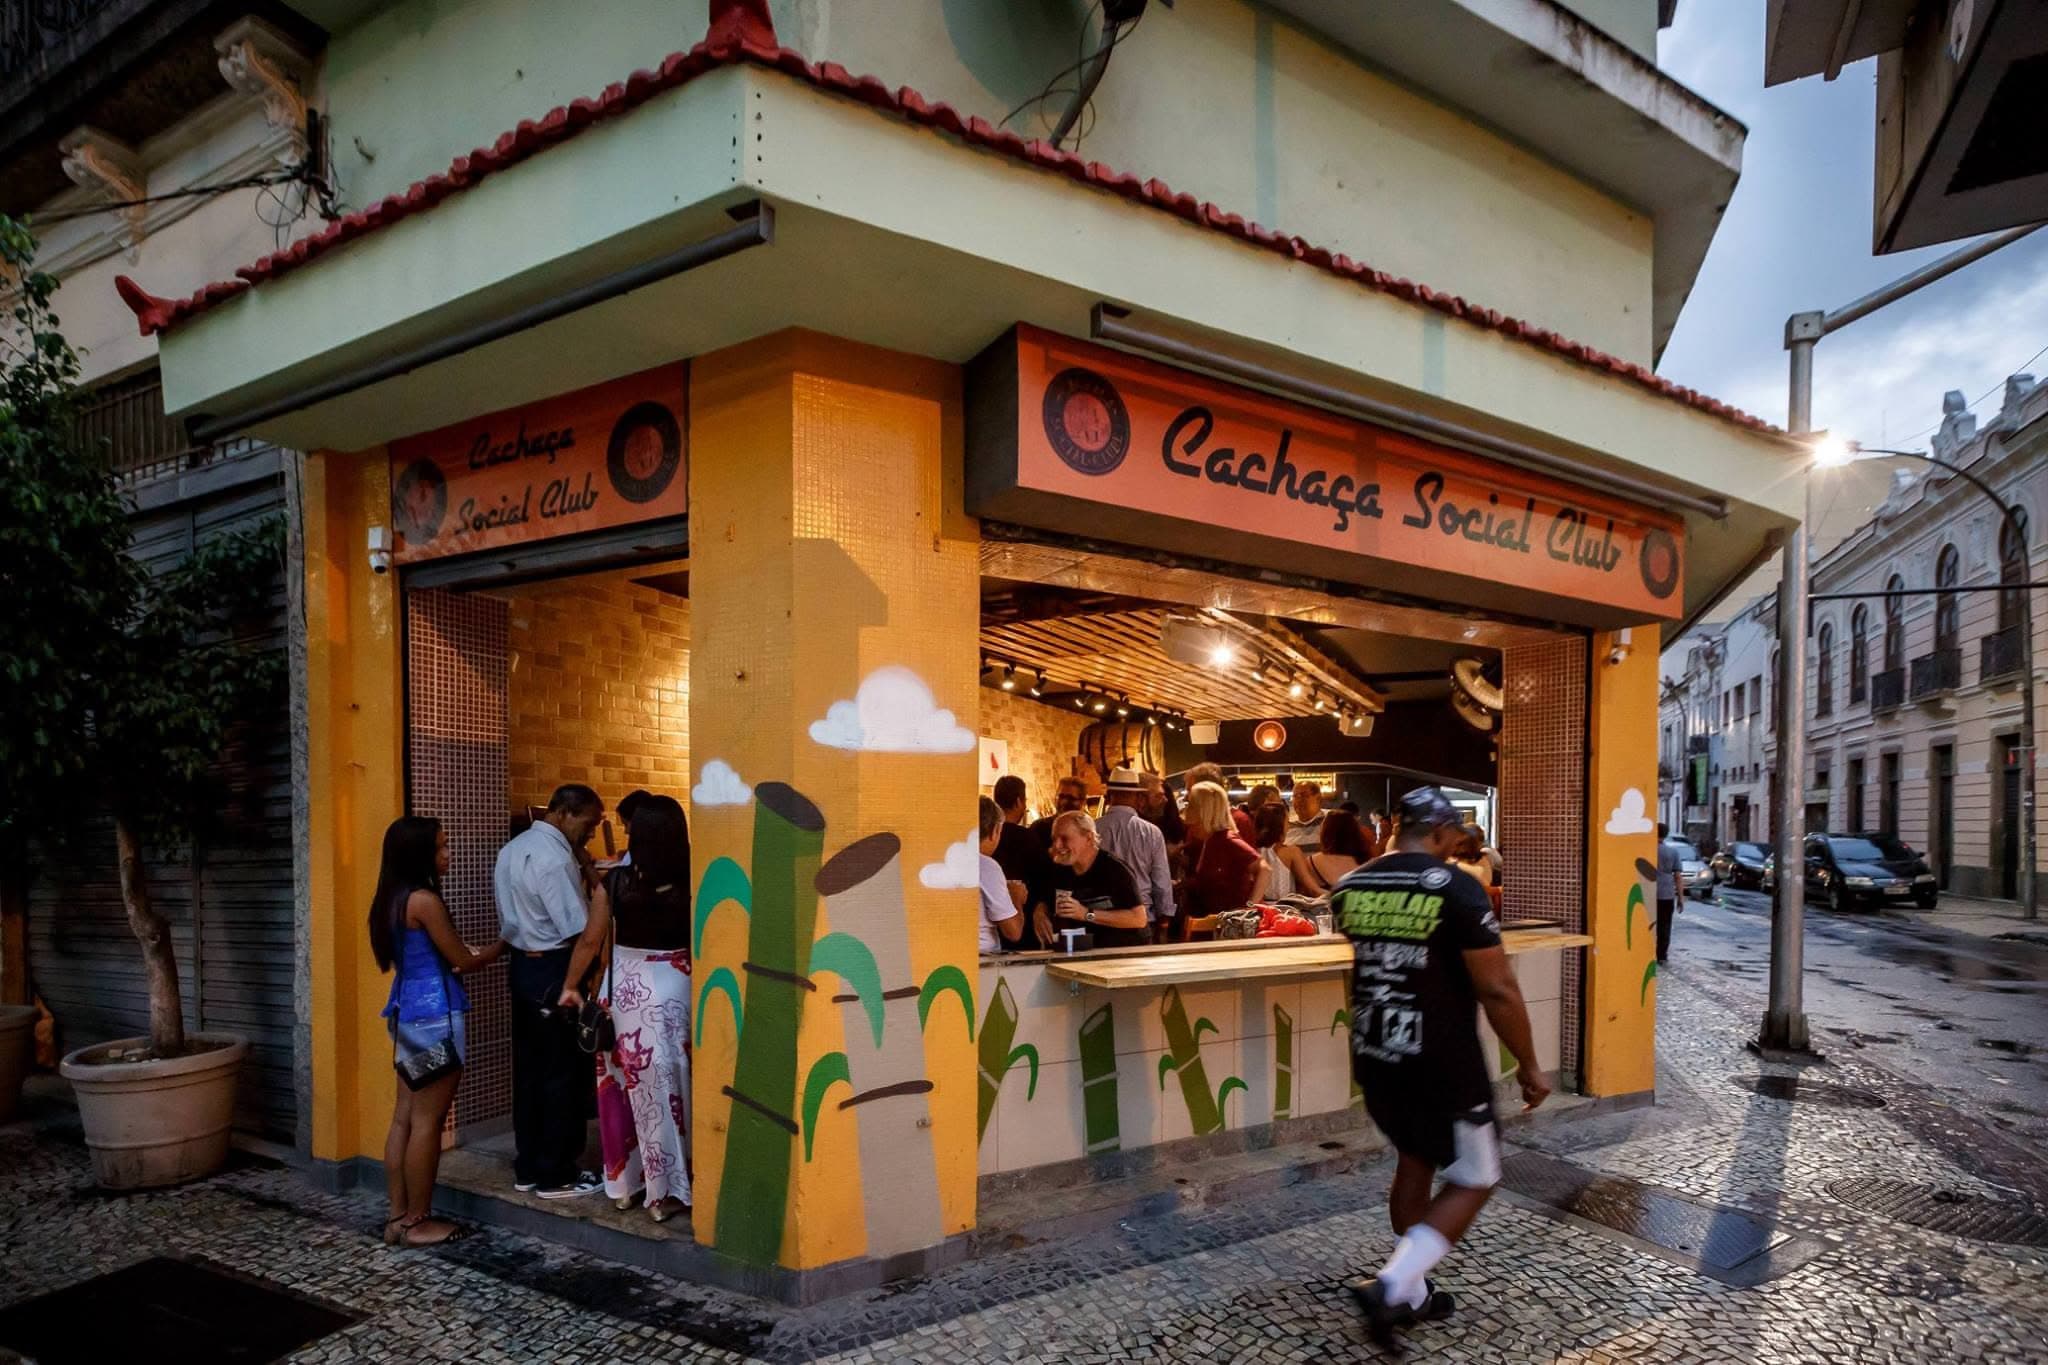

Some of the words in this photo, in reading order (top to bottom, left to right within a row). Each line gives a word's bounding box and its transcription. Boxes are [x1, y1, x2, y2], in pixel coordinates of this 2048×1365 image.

[468, 423, 576, 470] Cachaça
[455, 483, 529, 533] Social
[540, 472, 599, 520] Club
[1162, 406, 1383, 531] Cachaça
[1403, 471, 1530, 553] Social
[1547, 507, 1622, 572] Club
[1337, 889, 1444, 918] USCULAR
